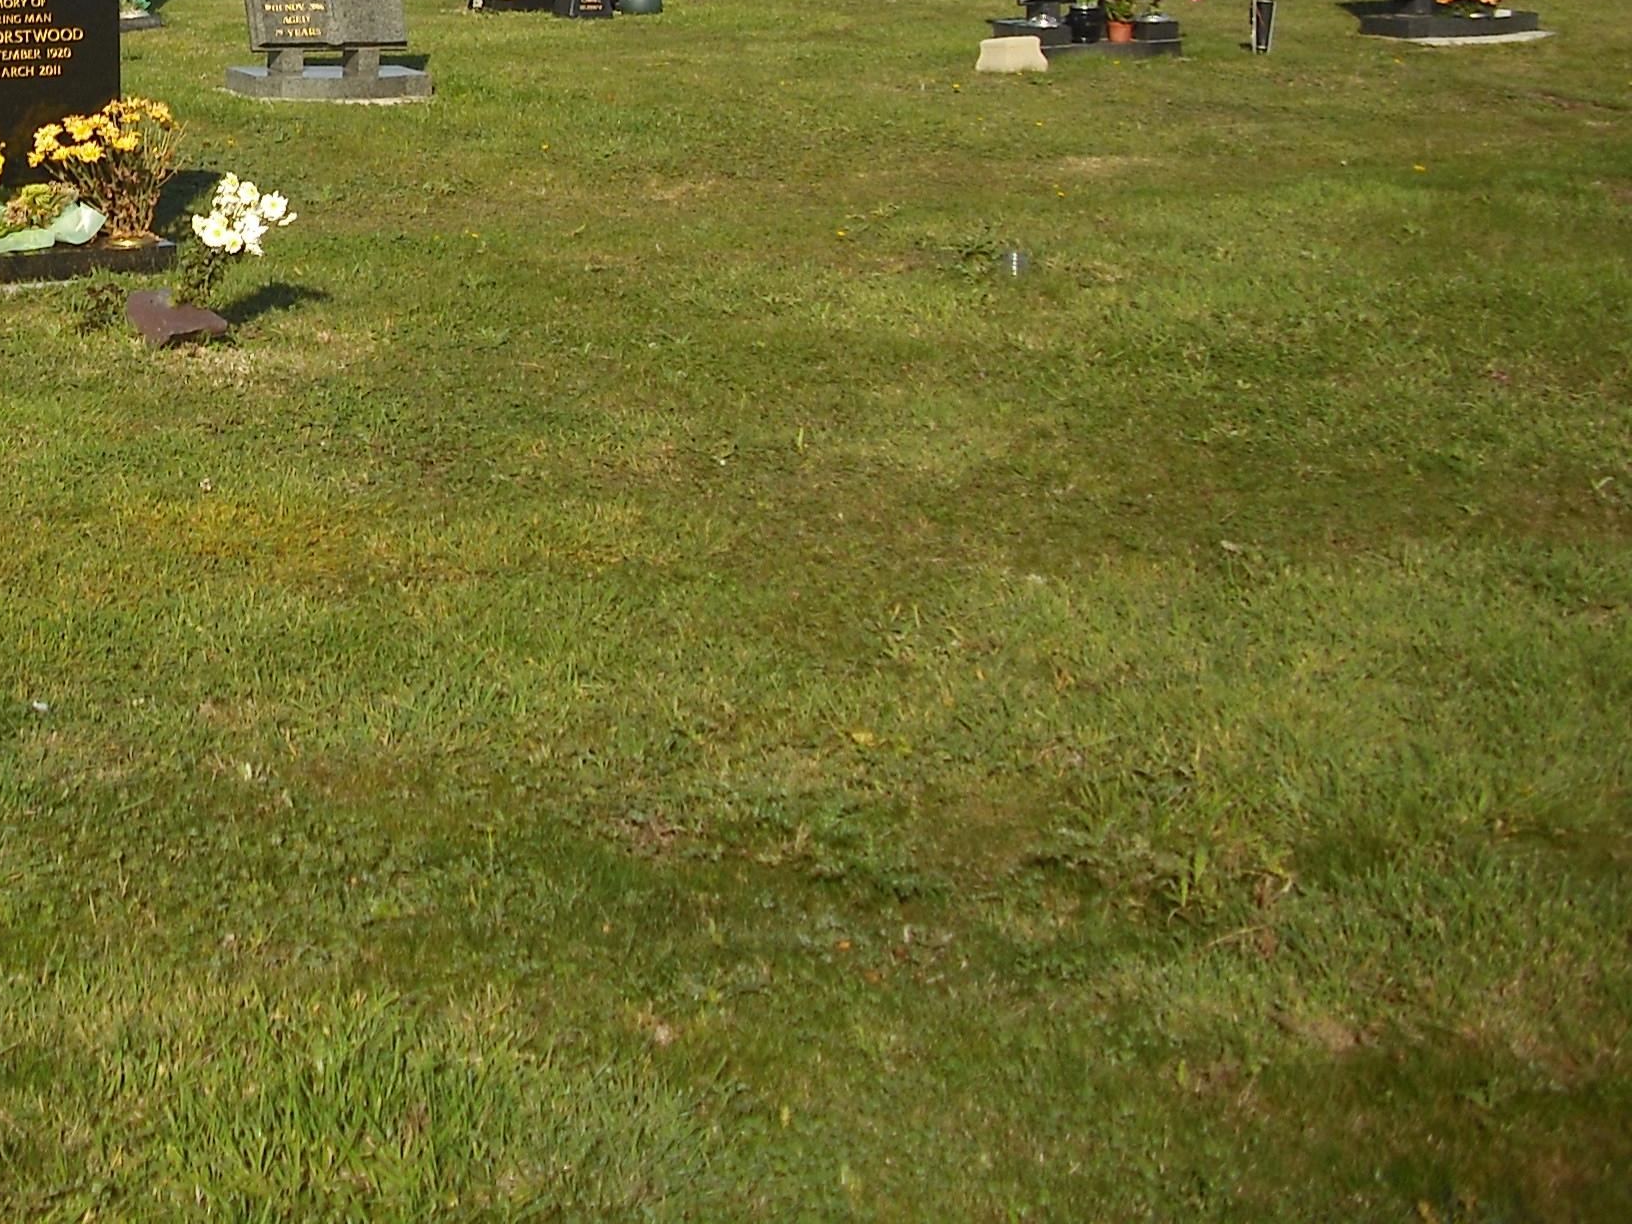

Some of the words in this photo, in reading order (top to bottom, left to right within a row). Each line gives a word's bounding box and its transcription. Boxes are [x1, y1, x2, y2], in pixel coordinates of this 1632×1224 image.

[284, 2, 305, 12] NOV
[24, 13, 52, 24] MAN
[282, 16, 311, 24] AGED
[287, 27, 322, 37] YEARS
[46, 47, 72, 59] 1920
[38, 64, 62, 76] 2011
